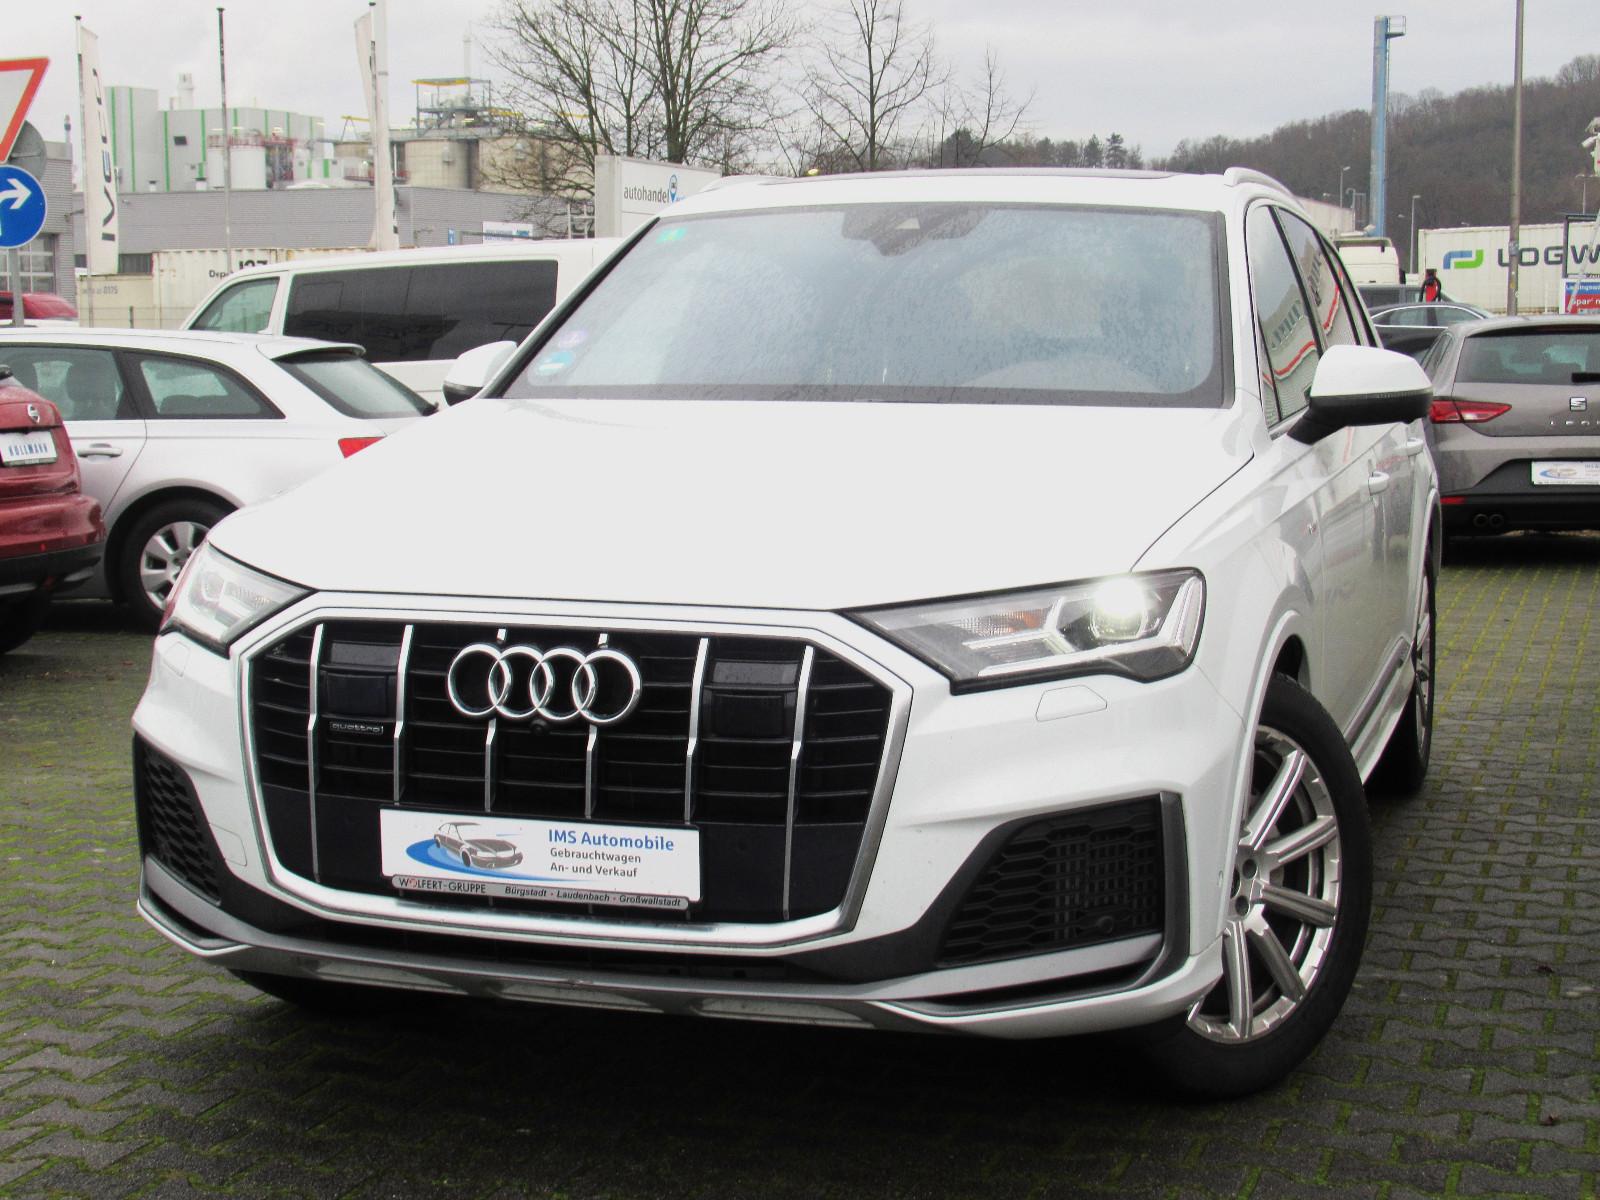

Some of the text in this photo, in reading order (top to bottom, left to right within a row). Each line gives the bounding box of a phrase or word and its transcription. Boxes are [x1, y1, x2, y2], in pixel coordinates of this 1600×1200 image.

[623, 186, 670, 204] autohandel
[332, 723, 381, 733] quattro
[548, 829, 674, 851] IMS Automobile
[550, 847, 641, 864] Gebrauchtwagen
[550, 862, 637, 877] An- und Verkauf
[505, 886, 547, 898] Bürgstadt
[557, 890, 610, 902] Laudenbach
[619, 894, 681, 907] Großwallstadt
